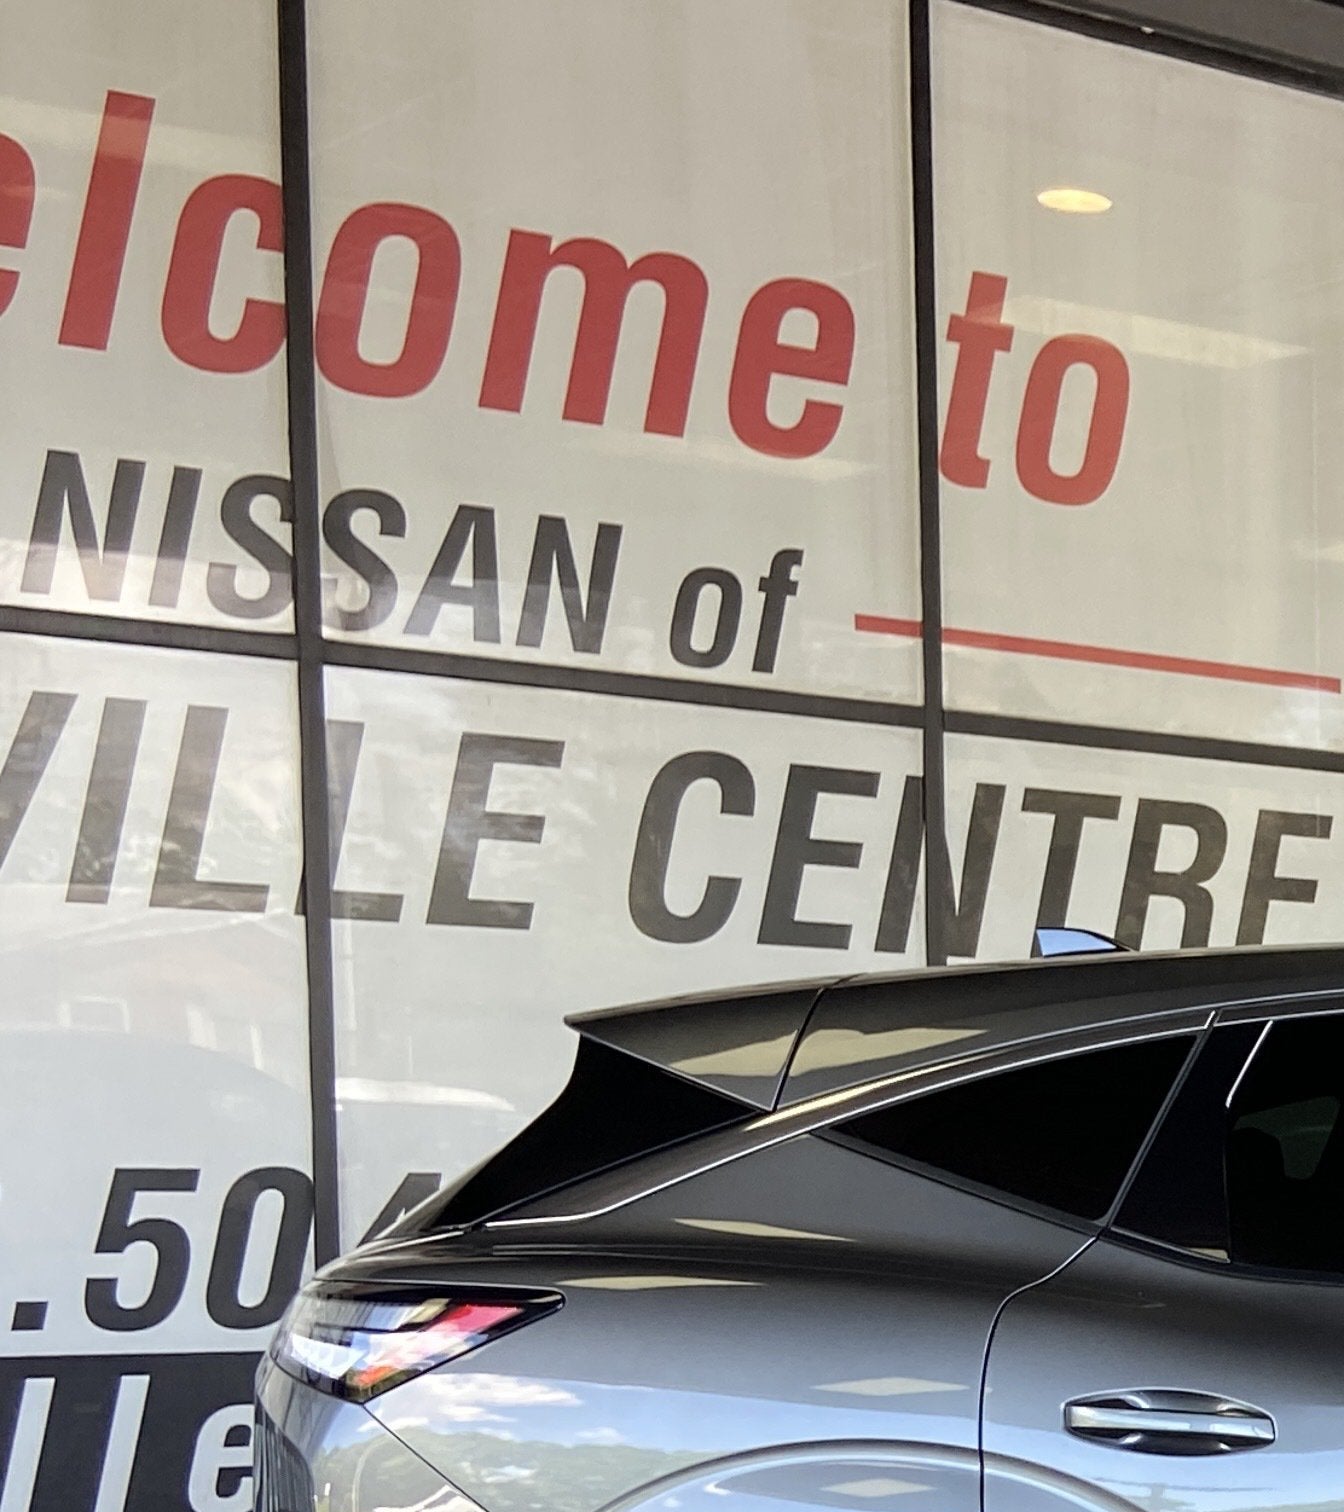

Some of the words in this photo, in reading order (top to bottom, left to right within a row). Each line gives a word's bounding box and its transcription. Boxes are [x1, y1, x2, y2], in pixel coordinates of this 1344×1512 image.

[0, 89, 855, 460] lcome
[939, 270, 1131, 507] to
[19, 448, 624, 655] NISSAN
[668, 547, 804, 674] of
